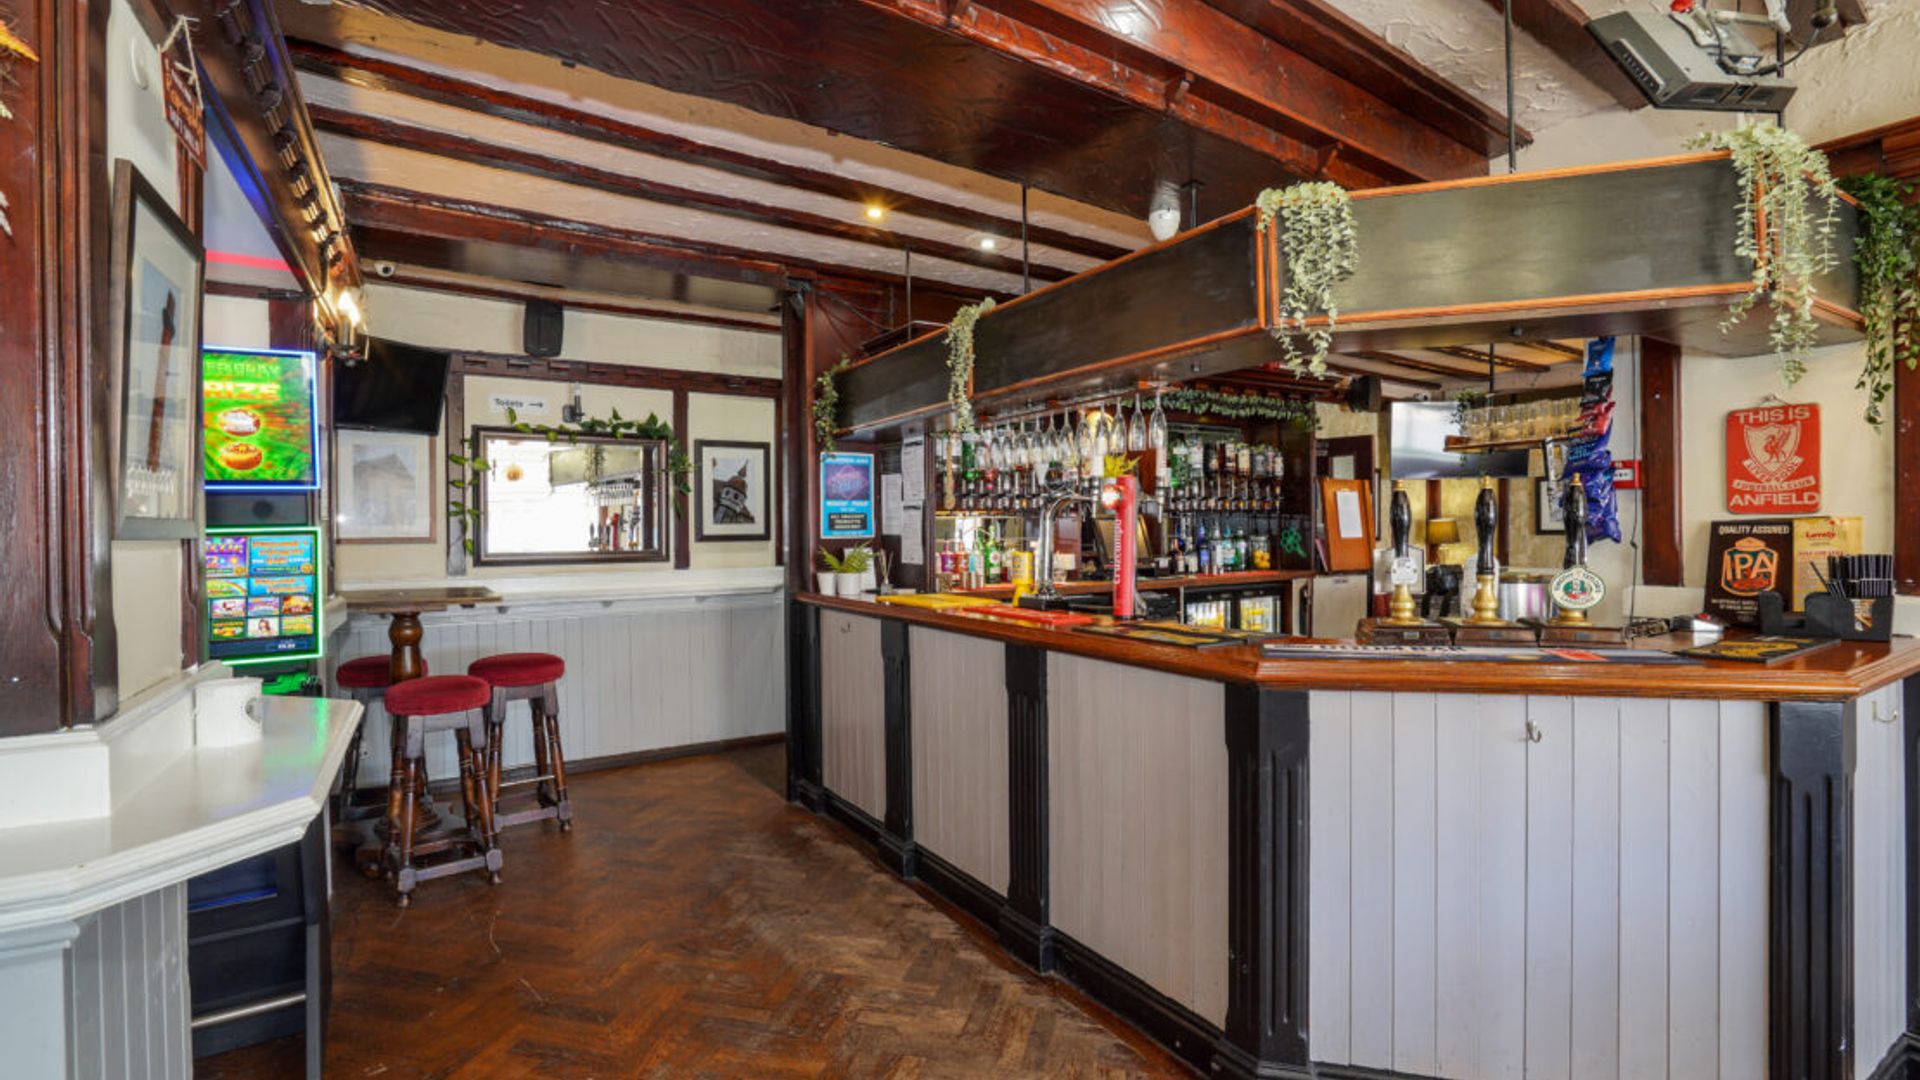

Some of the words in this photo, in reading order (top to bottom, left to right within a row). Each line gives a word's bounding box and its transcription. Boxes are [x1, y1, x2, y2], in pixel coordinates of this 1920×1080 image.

[494, 398, 523, 408] Toilets
[1737, 408, 1784, 424] THIS
[1789, 406, 1811, 420] IS
[1729, 492, 1820, 507] ANFIELD
[1719, 525, 1751, 535] QUALITY
[1725, 552, 1774, 581] IPA
